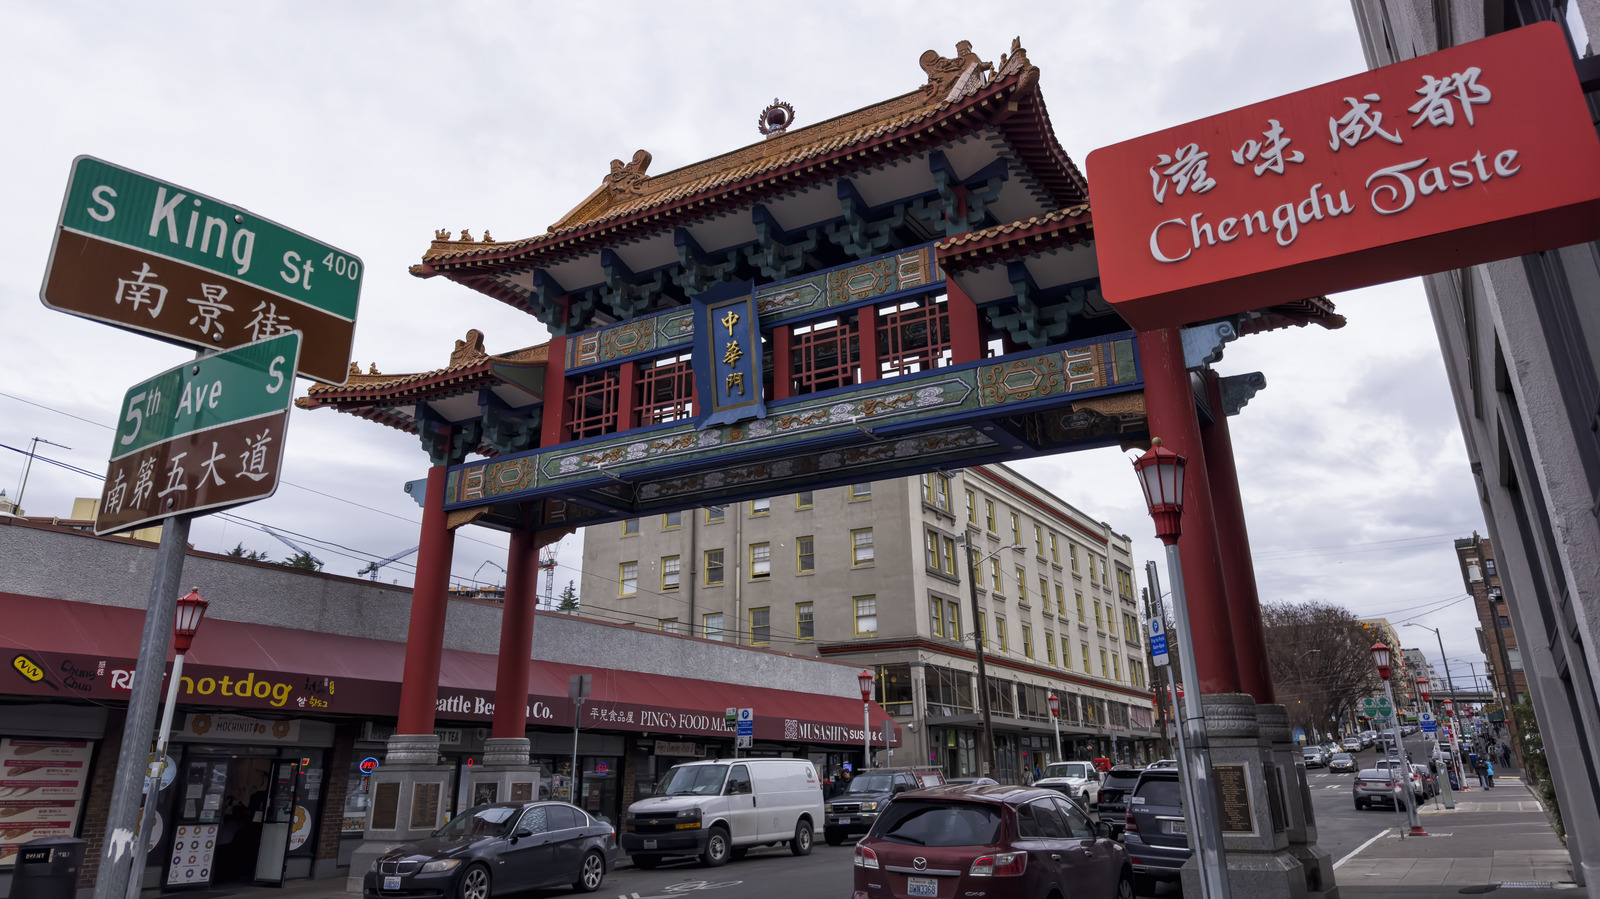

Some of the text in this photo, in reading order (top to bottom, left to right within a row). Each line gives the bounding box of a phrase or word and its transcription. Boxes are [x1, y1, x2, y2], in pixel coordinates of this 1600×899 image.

[1149, 65, 1493, 204] 滋味成都
[1148, 148, 1522, 264] Chengdu Taste
[86, 184, 358, 291] S King St 400
[721, 310, 745, 397] 中華門
[120, 355, 286, 446] 5th Ave S
[104, 427, 273, 516] 南第五大道
[216, 721, 254, 732] MOCHINUT
[435, 695, 472, 714] attle
[474, 696, 495, 715] Be
[532, 701, 553, 719] Co.
[679, 713, 710, 731] FOOD
[711, 717, 737, 733] MA
[798, 722, 849, 742] MUSASHI'S
[849, 729, 872, 740] SUSI
[448, 731, 459, 743] TEA
[360, 761, 378, 770] OPEN
